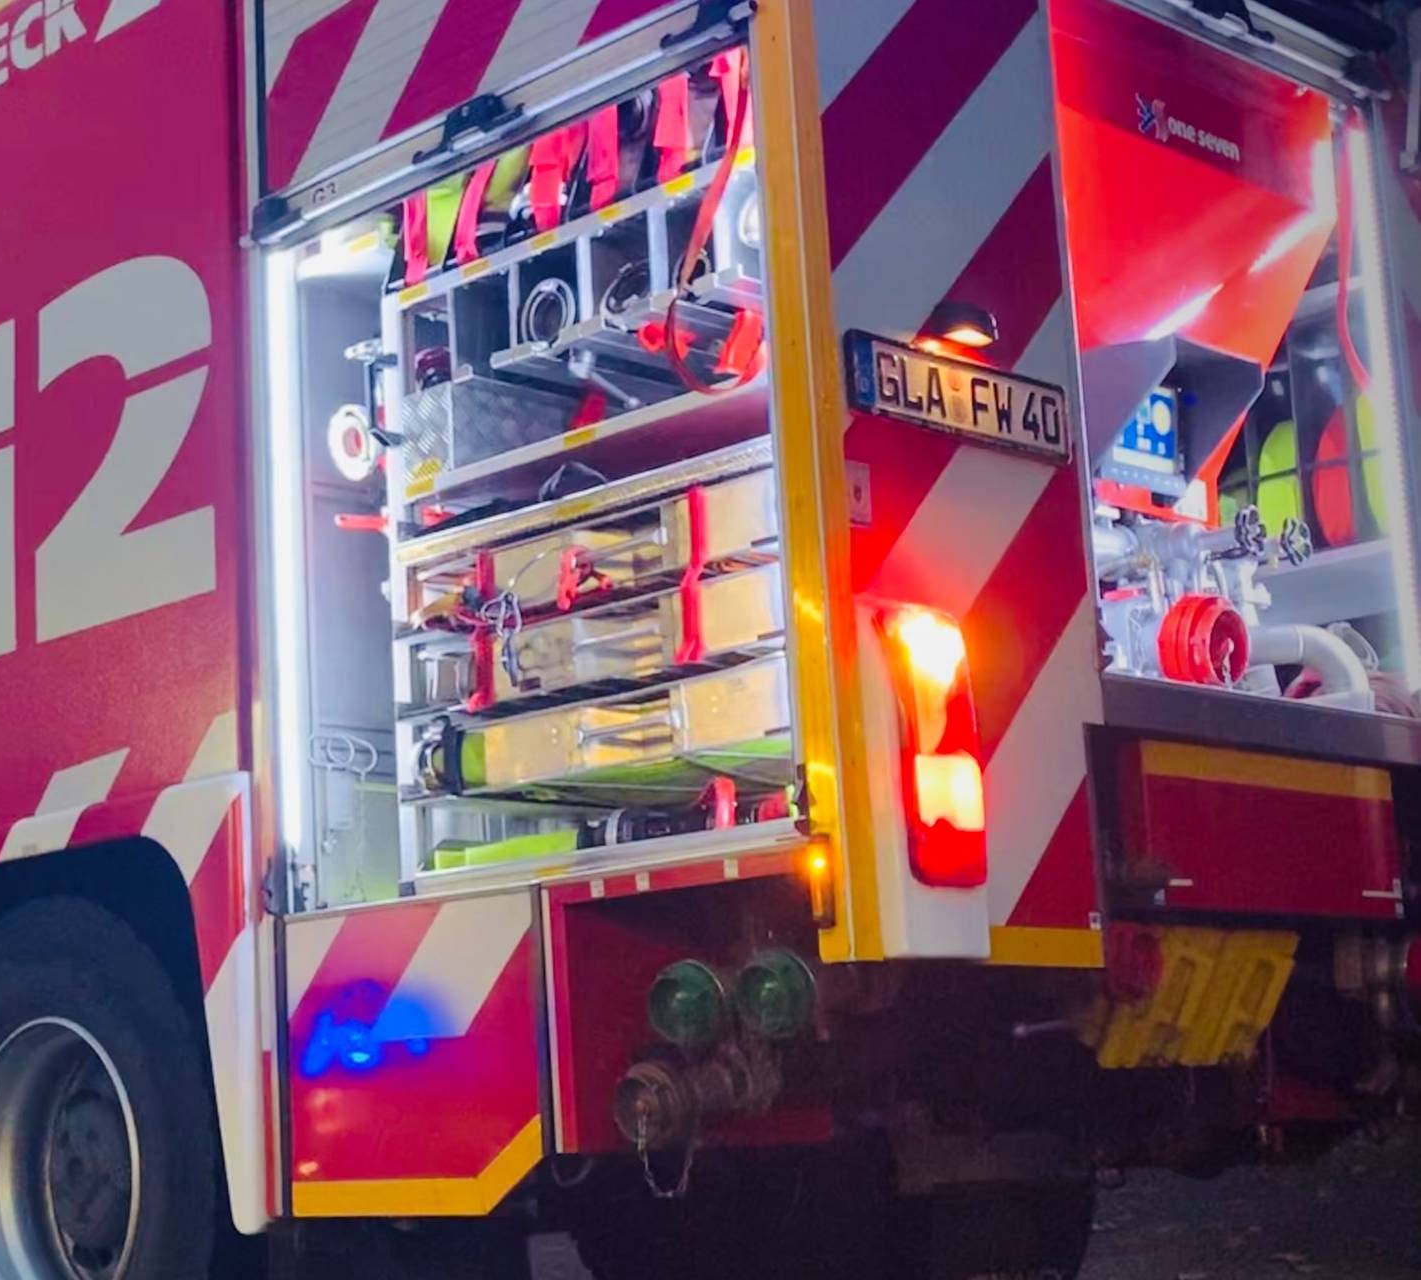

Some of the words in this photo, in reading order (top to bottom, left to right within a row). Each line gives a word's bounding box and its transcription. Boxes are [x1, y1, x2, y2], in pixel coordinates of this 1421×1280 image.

[1168, 116, 1196, 143] one
[1198, 129, 1240, 162] seven
[878, 352, 947, 419] GLA
[971, 377, 1012, 434] FW
[1022, 391, 1061, 445] 40
